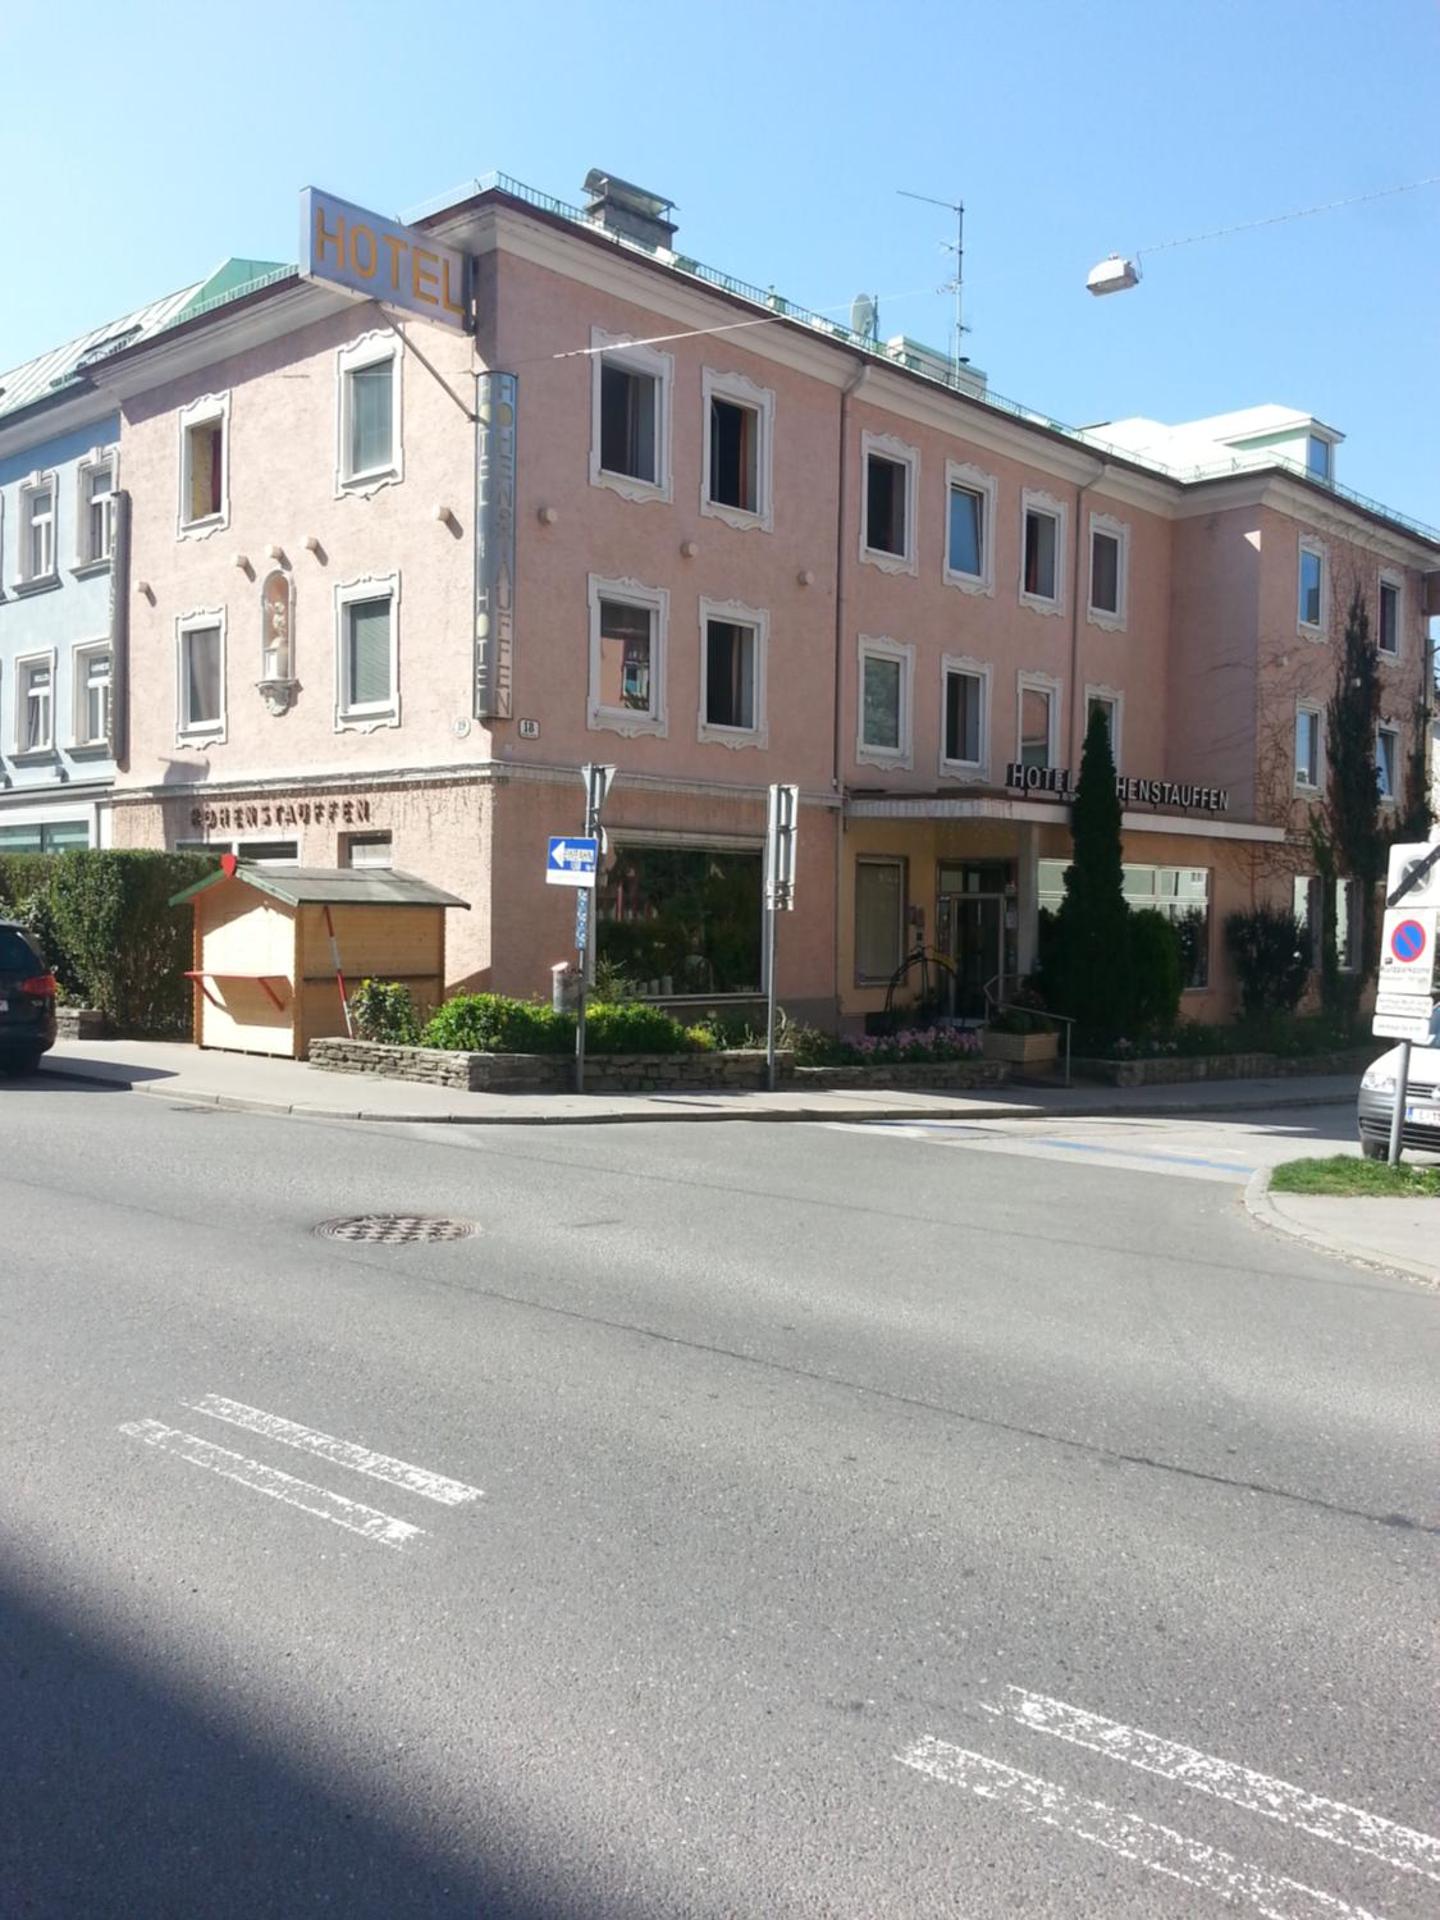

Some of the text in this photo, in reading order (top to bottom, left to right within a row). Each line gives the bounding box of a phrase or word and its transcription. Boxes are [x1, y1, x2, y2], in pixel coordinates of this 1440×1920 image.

[315, 206, 466, 317] HOTEL
[1010, 764, 1075, 791] HOTEL
[1116, 776, 1229, 810] HENSTAUFFEN
